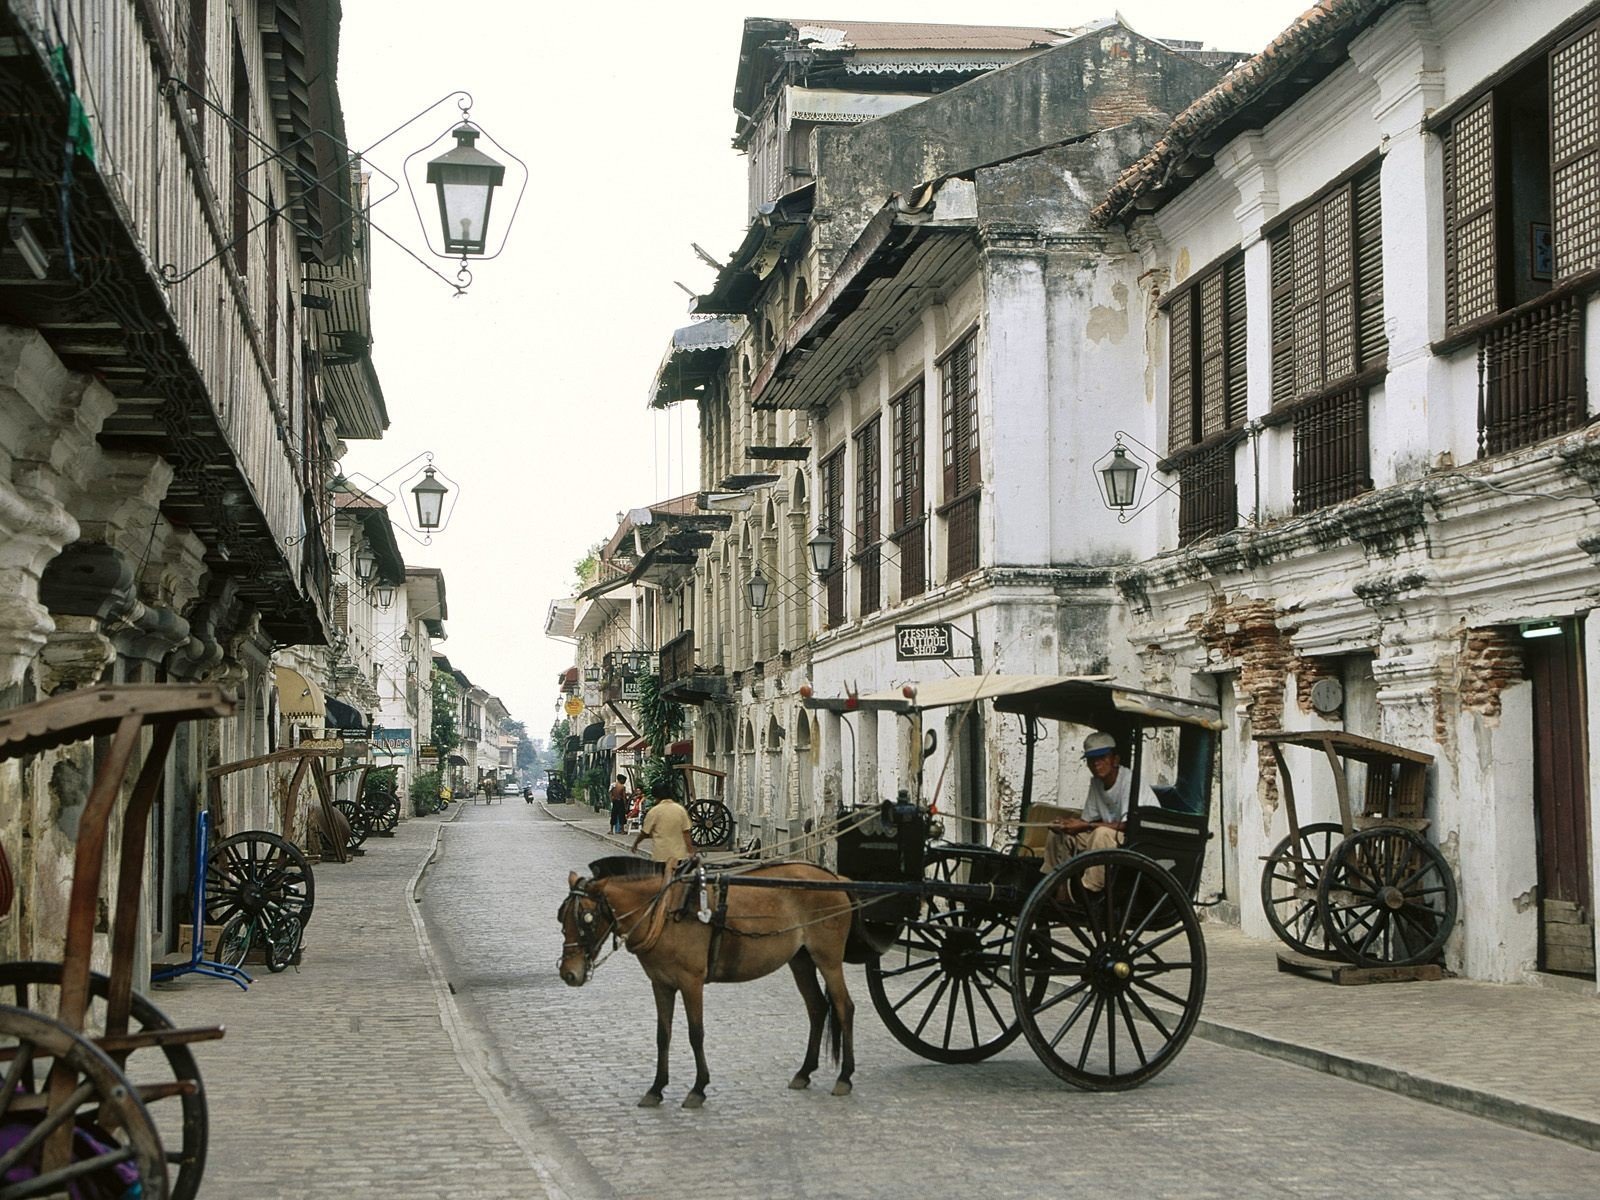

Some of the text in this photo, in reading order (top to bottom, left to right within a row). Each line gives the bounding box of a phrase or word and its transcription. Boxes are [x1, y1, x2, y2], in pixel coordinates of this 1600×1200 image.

[904, 626, 939, 637] TESSIE'S
[902, 636, 946, 648] ANTIQUE
[913, 646, 938, 656] SHOP
